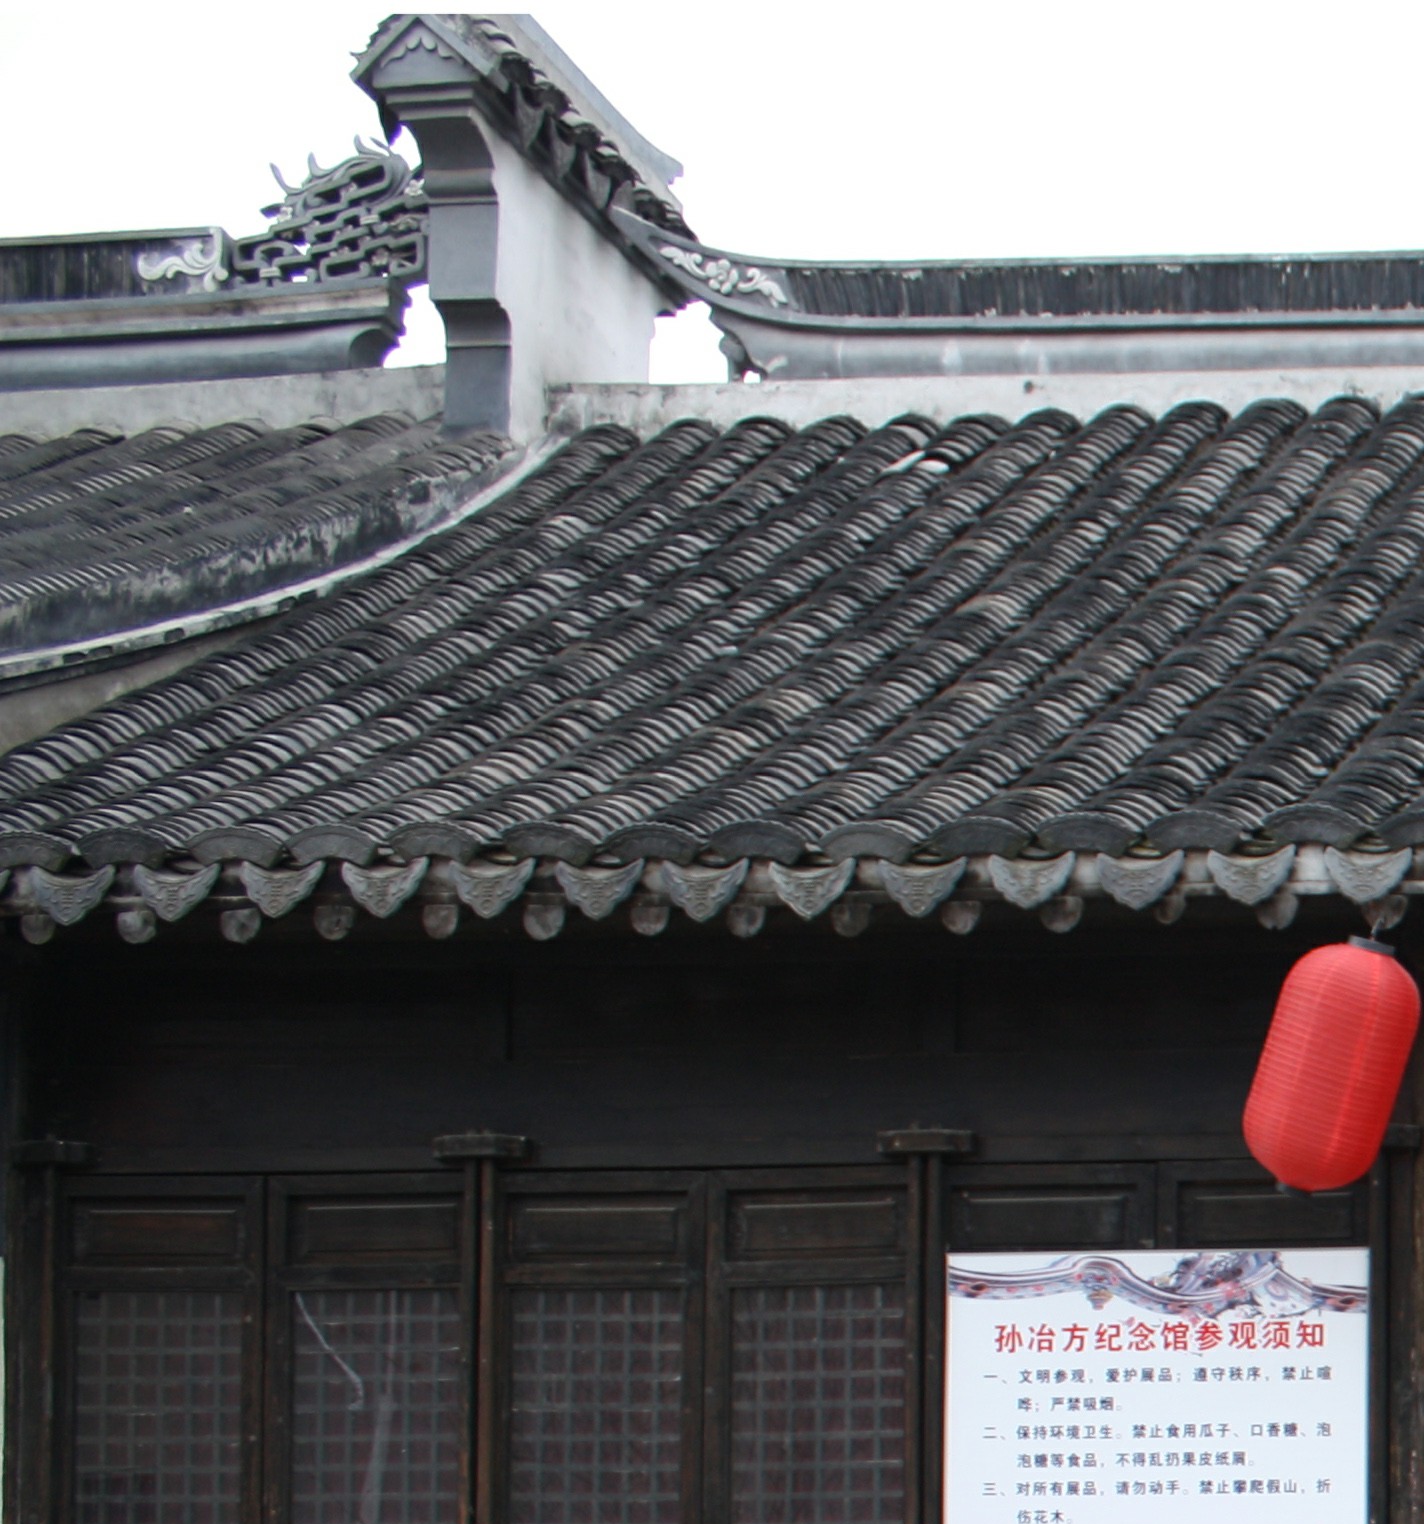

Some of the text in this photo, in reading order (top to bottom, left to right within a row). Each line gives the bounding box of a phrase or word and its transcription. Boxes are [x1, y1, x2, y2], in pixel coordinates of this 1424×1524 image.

[994, 1320, 1326, 1353] 孙冶方纪念馆参观须知
